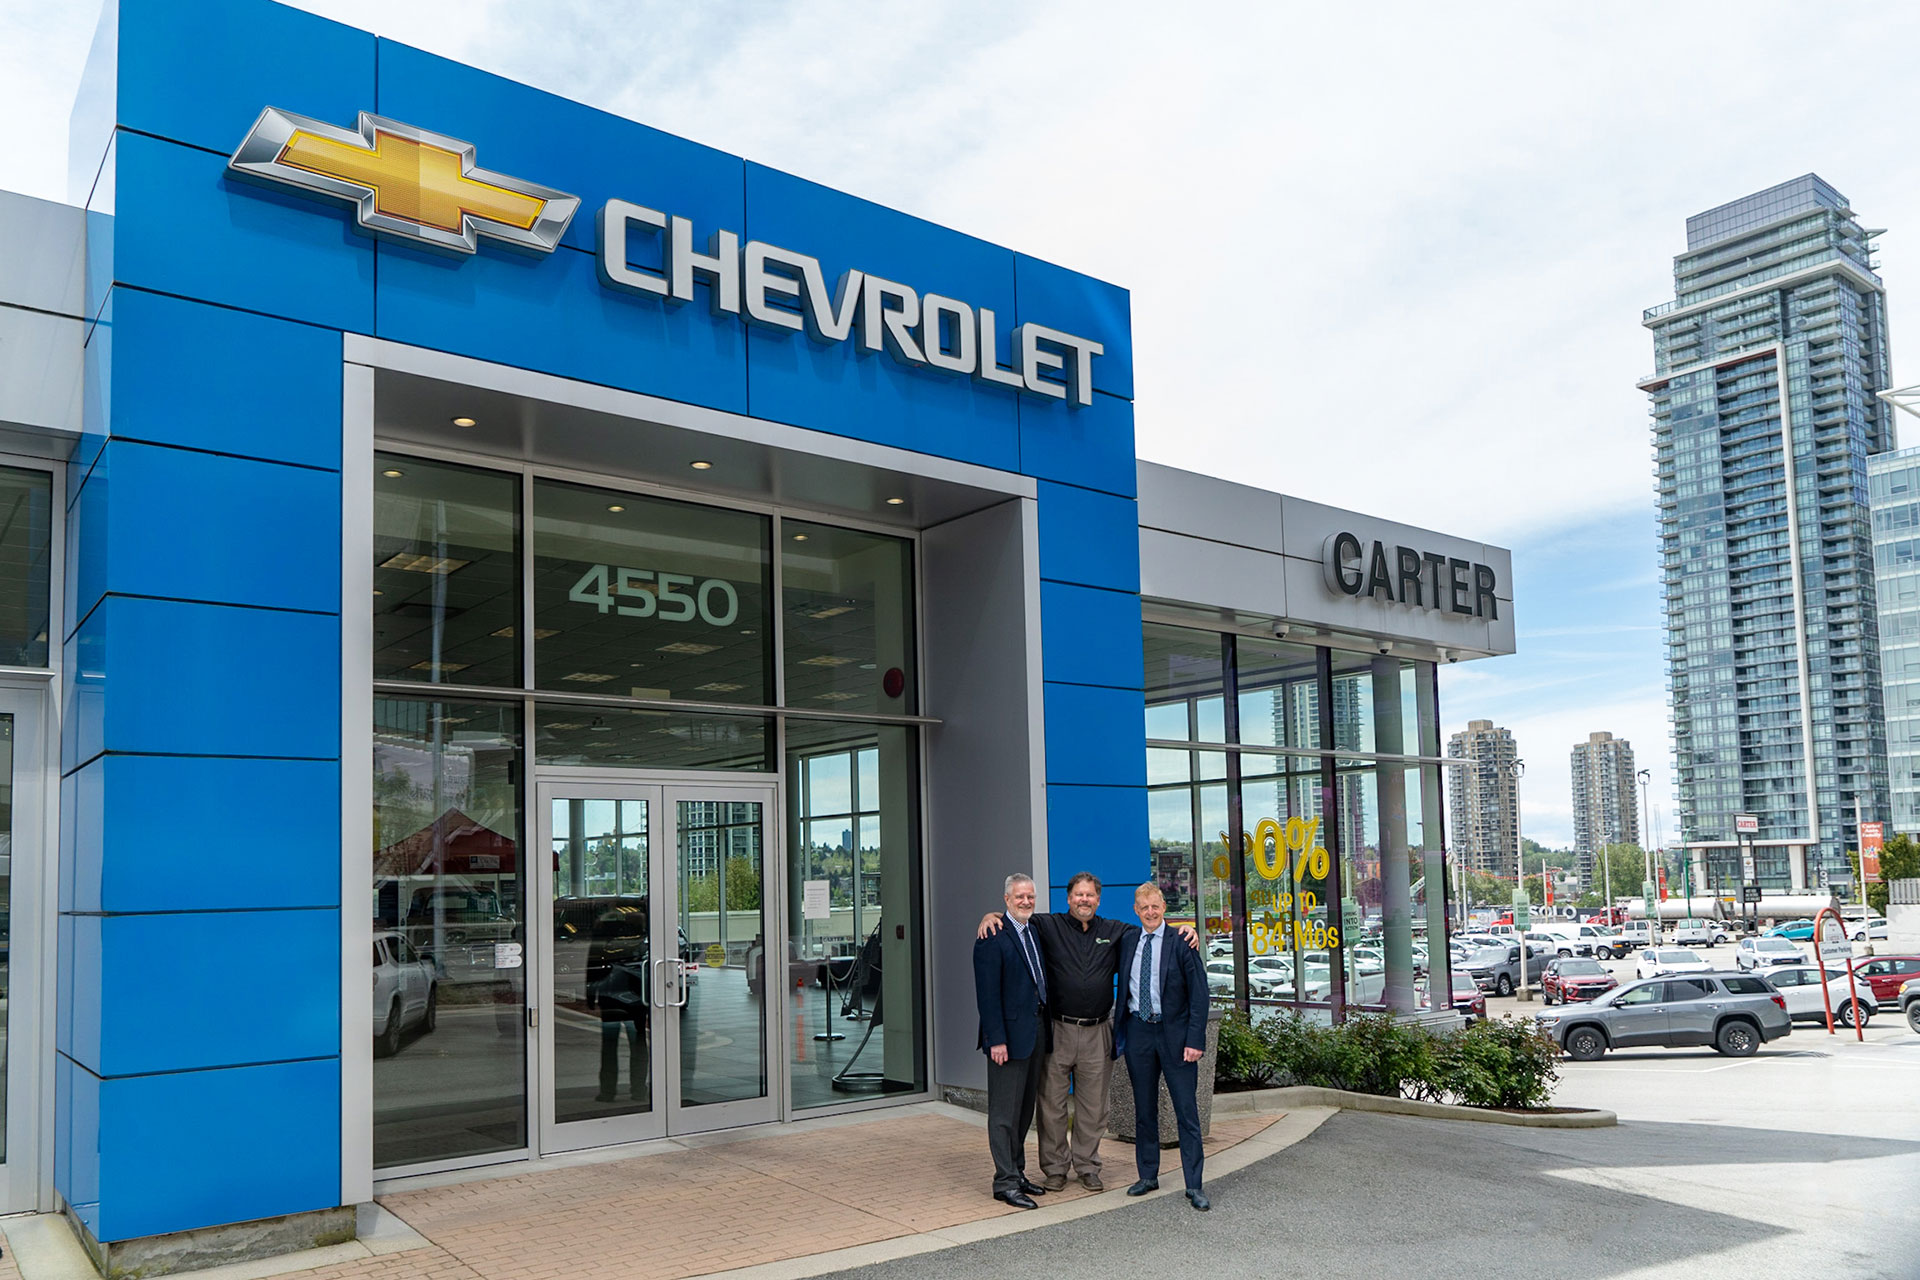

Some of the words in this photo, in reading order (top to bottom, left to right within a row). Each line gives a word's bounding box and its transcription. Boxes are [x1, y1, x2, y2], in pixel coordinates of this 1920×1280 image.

[600, 198, 1104, 407] CHEVROLET
[569, 564, 739, 627] 4550
[1327, 531, 1498, 620] CARTER
[1272, 892, 1293, 912] UP
[1297, 891, 1316, 912] TO
[1529, 904, 1577, 920] SOLO
[1252, 922, 1286, 955] 84
